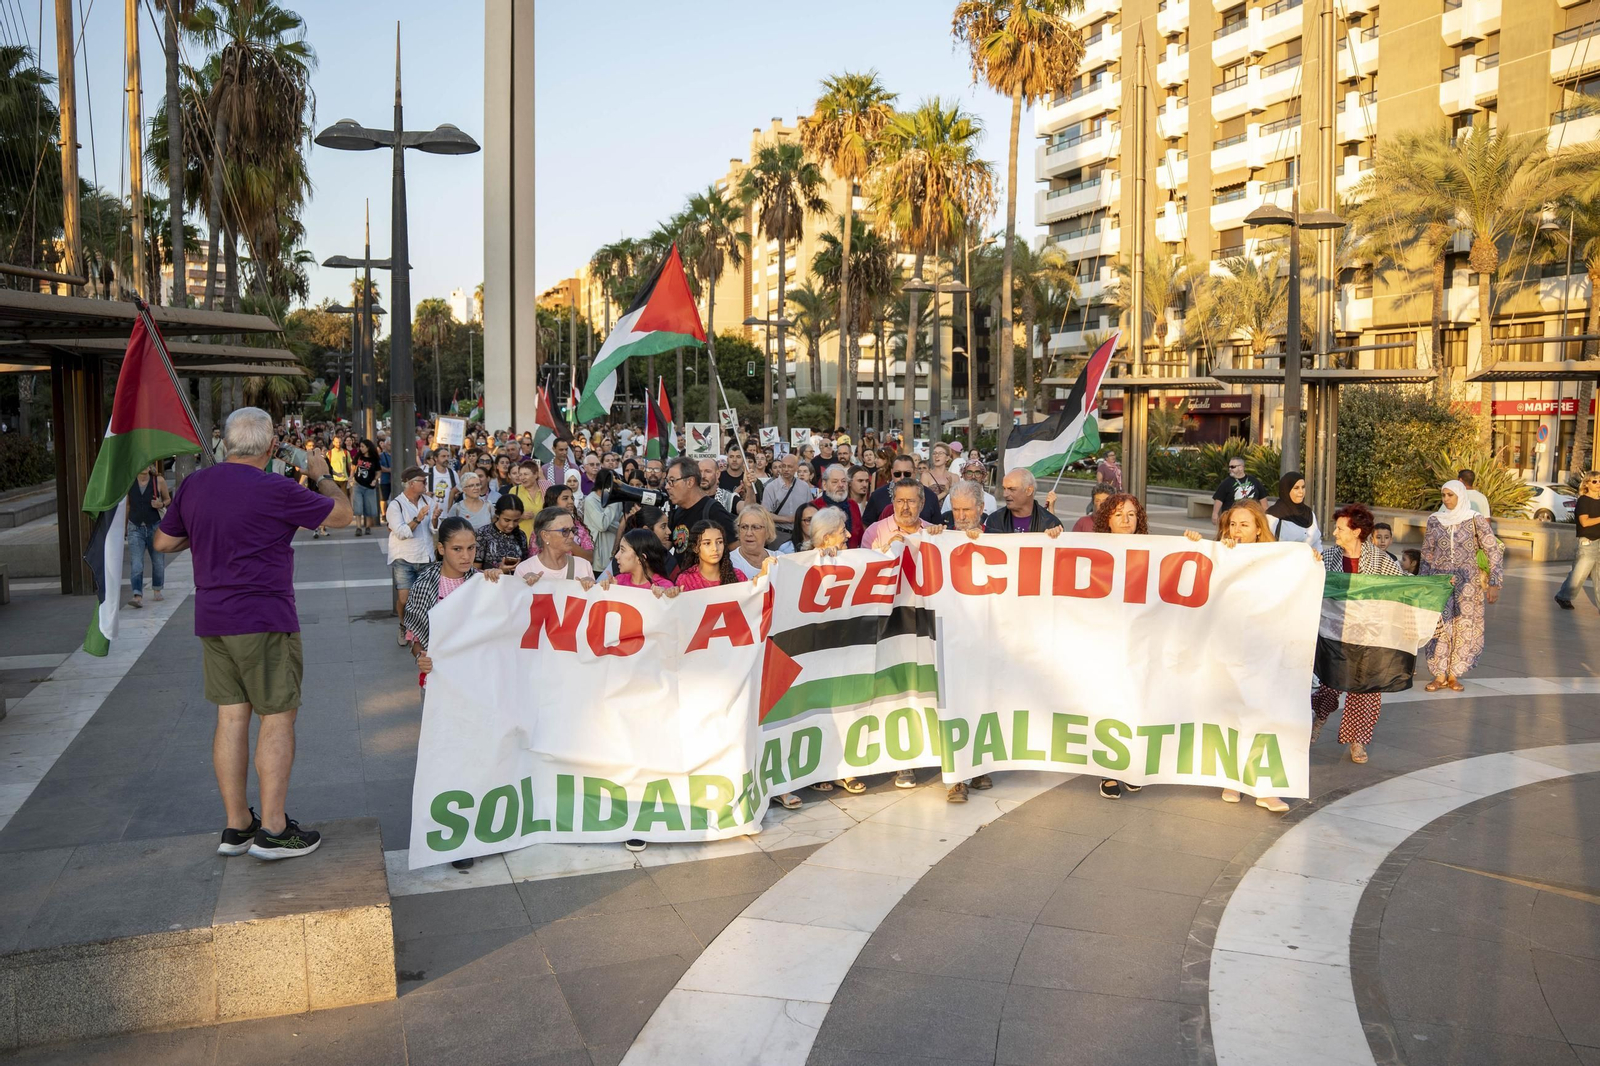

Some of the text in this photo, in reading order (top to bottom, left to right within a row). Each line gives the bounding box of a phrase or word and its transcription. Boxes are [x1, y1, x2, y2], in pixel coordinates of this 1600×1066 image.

[1524, 402, 1574, 412] MAPFRE
[520, 593, 645, 657] NO
[939, 710, 1290, 788] PALESTINA
